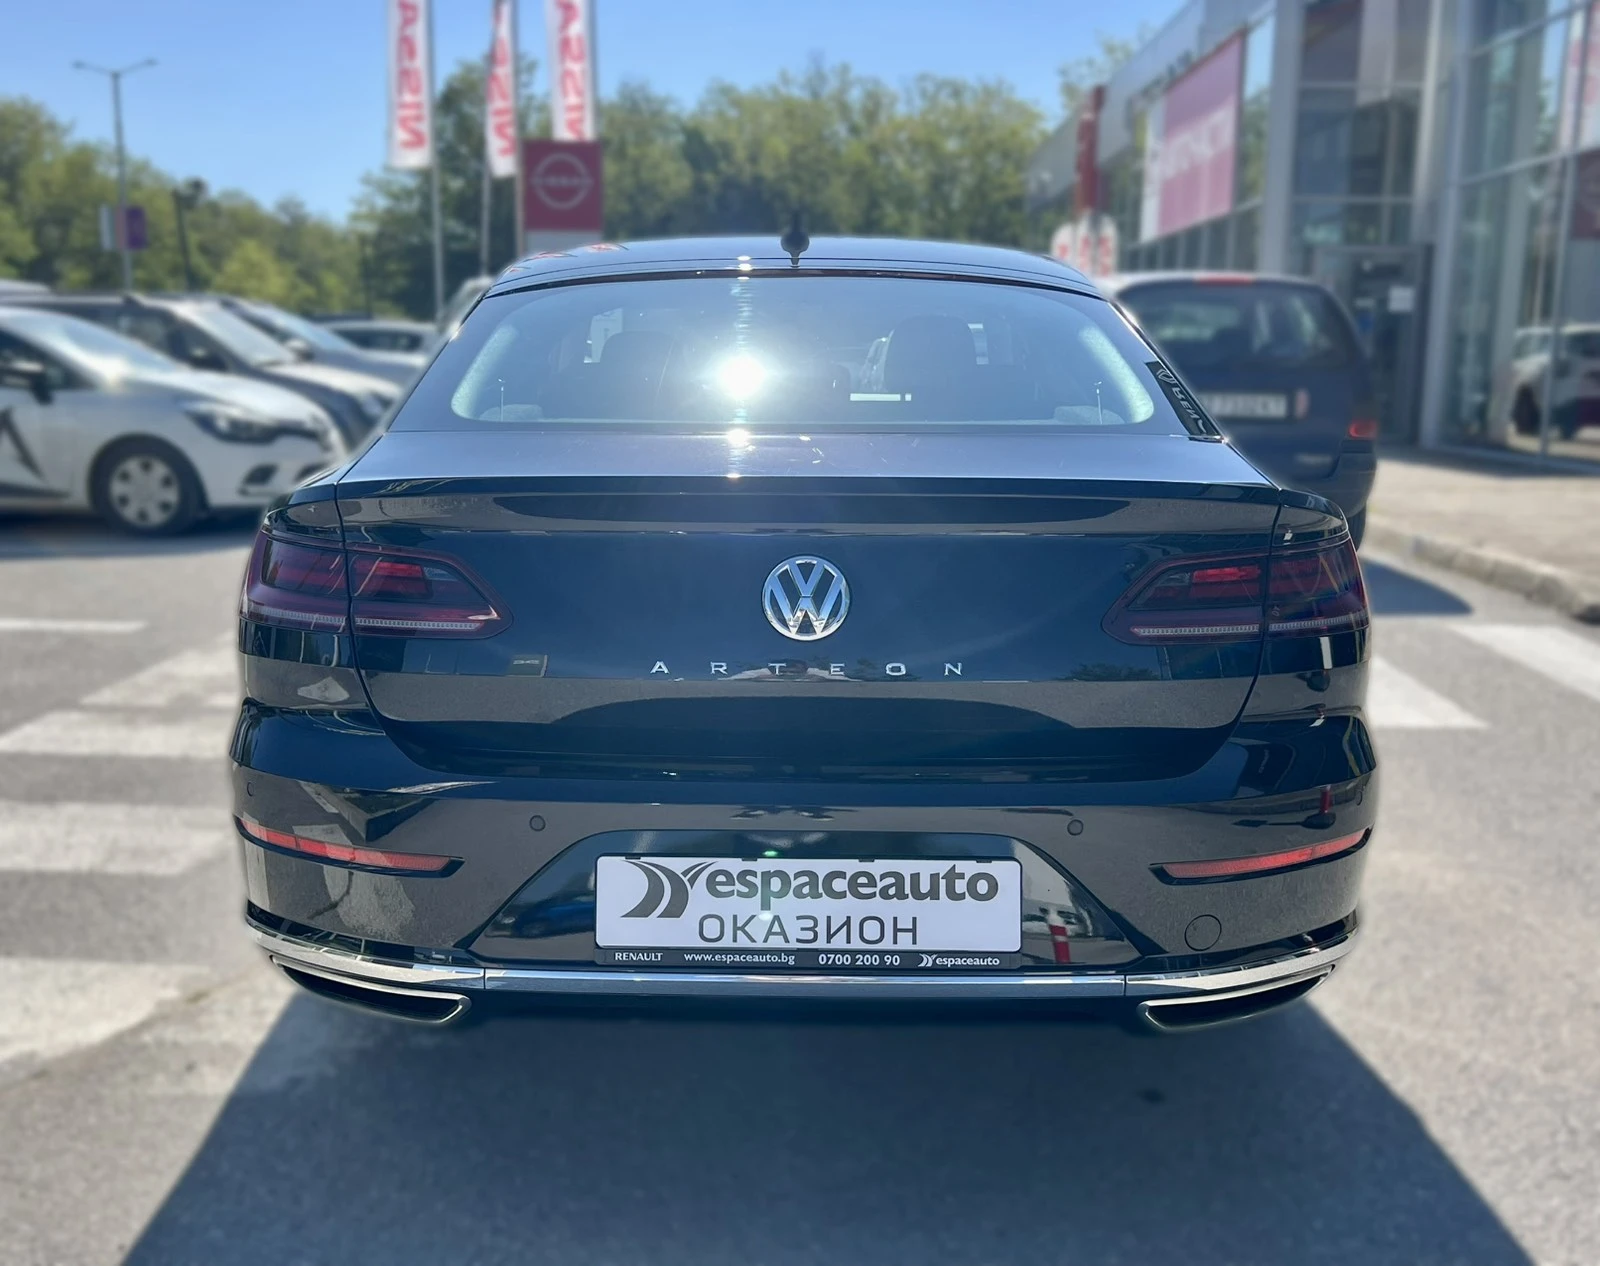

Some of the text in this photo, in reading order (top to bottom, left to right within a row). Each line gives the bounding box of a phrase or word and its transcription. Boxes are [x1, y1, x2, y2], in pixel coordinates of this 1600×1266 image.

[650, 660, 964, 677] ARTEON
[705, 863, 999, 911] espaceauto
[698, 914, 919, 946] ОКАЗИОН
[614, 952, 664, 962] RENAULT
[684, 953, 796, 965] www.espaceauto.bg
[818, 953, 900, 966] 0700 200 90
[936, 955, 1000, 968] espaceauto
